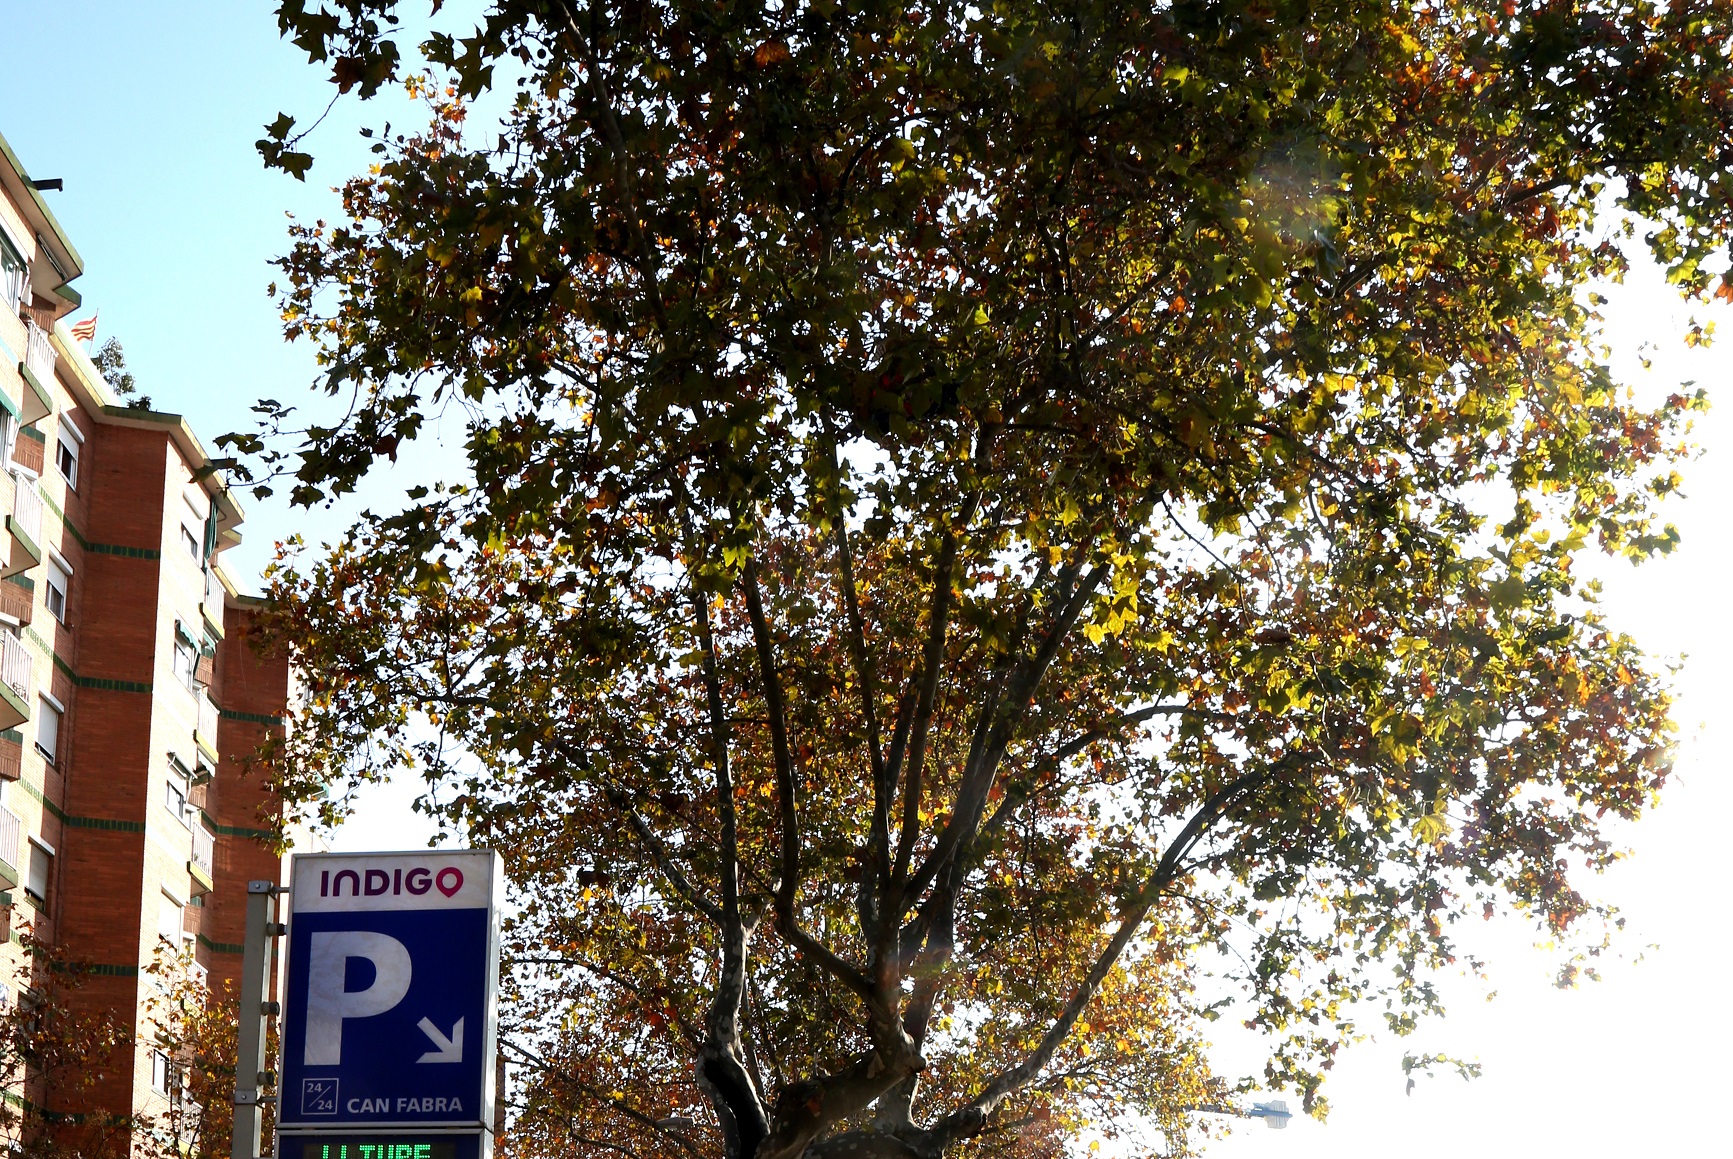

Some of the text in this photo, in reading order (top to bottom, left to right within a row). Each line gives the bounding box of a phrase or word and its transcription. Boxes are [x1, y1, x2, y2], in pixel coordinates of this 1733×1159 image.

[320, 866, 464, 898] INDIGO
[304, 930, 413, 1066] P
[306, 1082, 322, 1094] 24
[317, 1099, 333, 1111] 24
[346, 1096, 464, 1114] CAN FABRA
